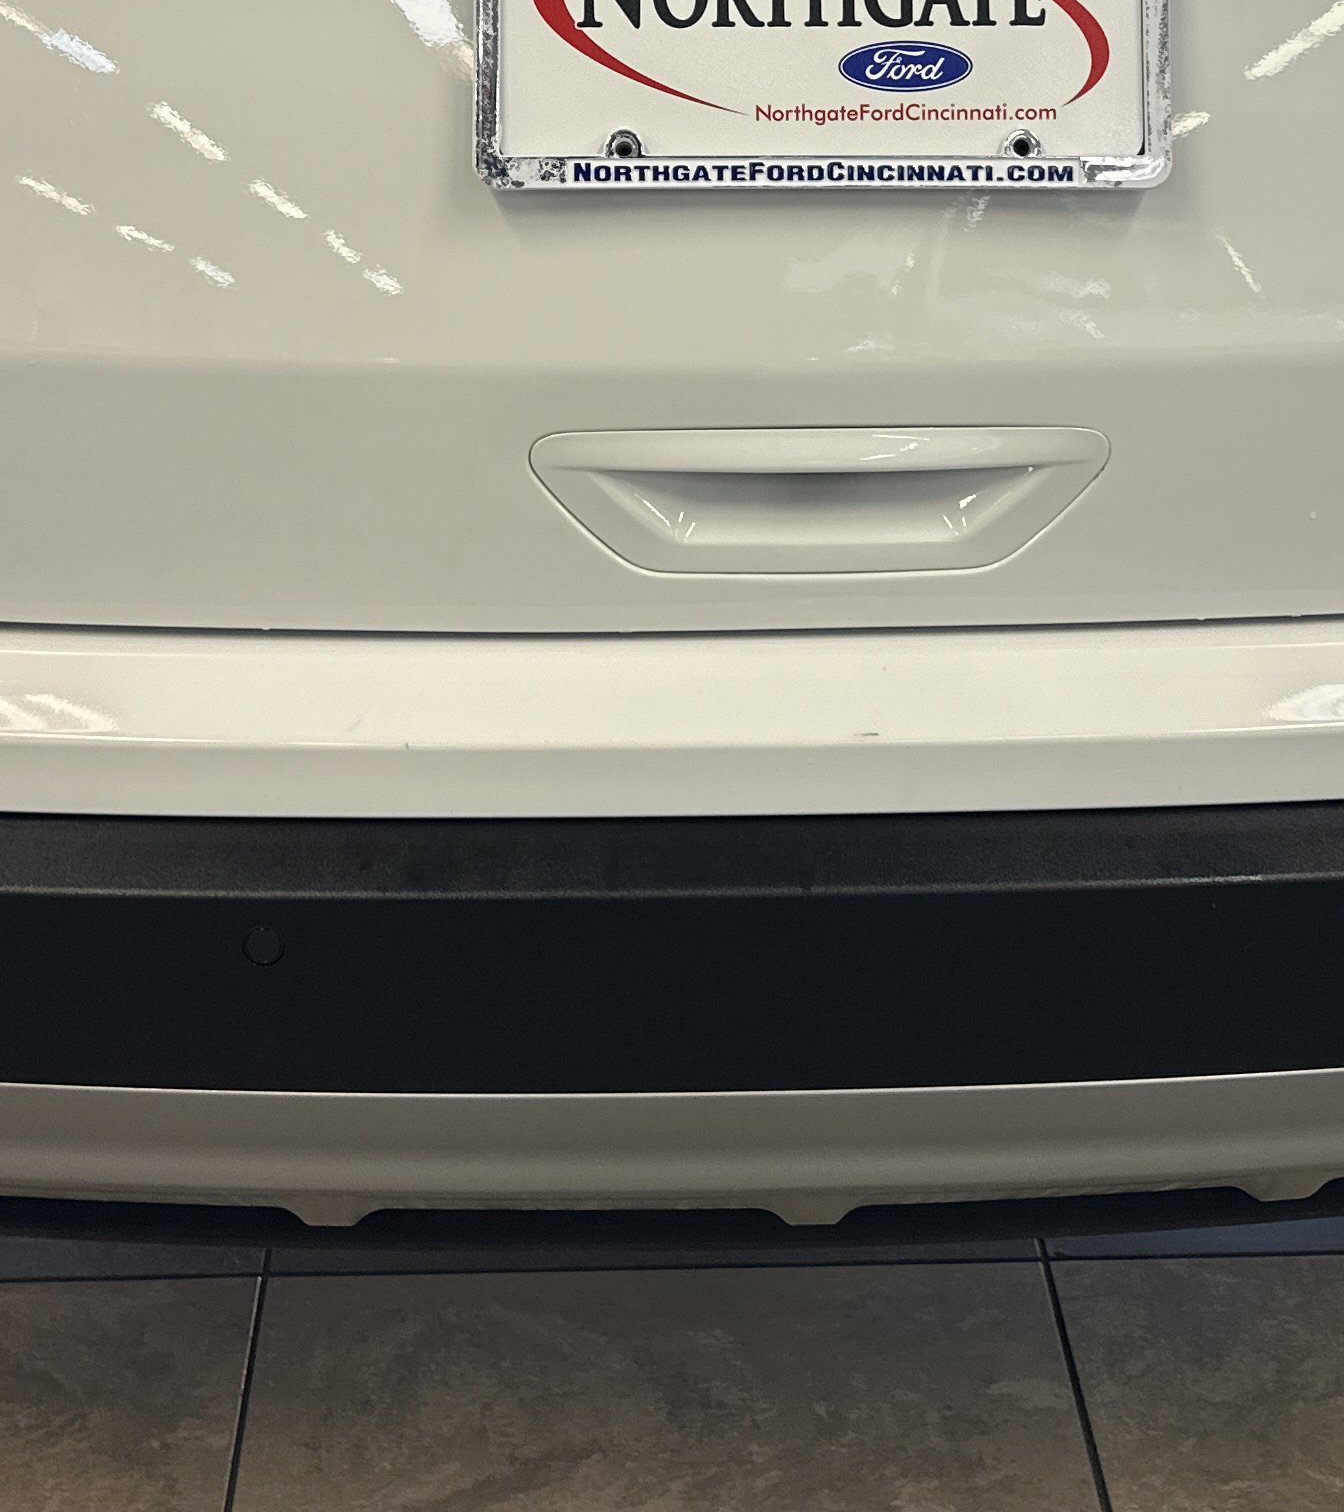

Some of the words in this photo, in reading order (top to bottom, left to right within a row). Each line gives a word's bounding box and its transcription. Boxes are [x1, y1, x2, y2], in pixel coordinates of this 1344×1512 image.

[864, 47, 945, 81] Ford
[755, 103, 1056, 126] NorthgateFordCincinnati.com
[572, 161, 1075, 183] NORTHGATEFORDCINCINNATI.COM
